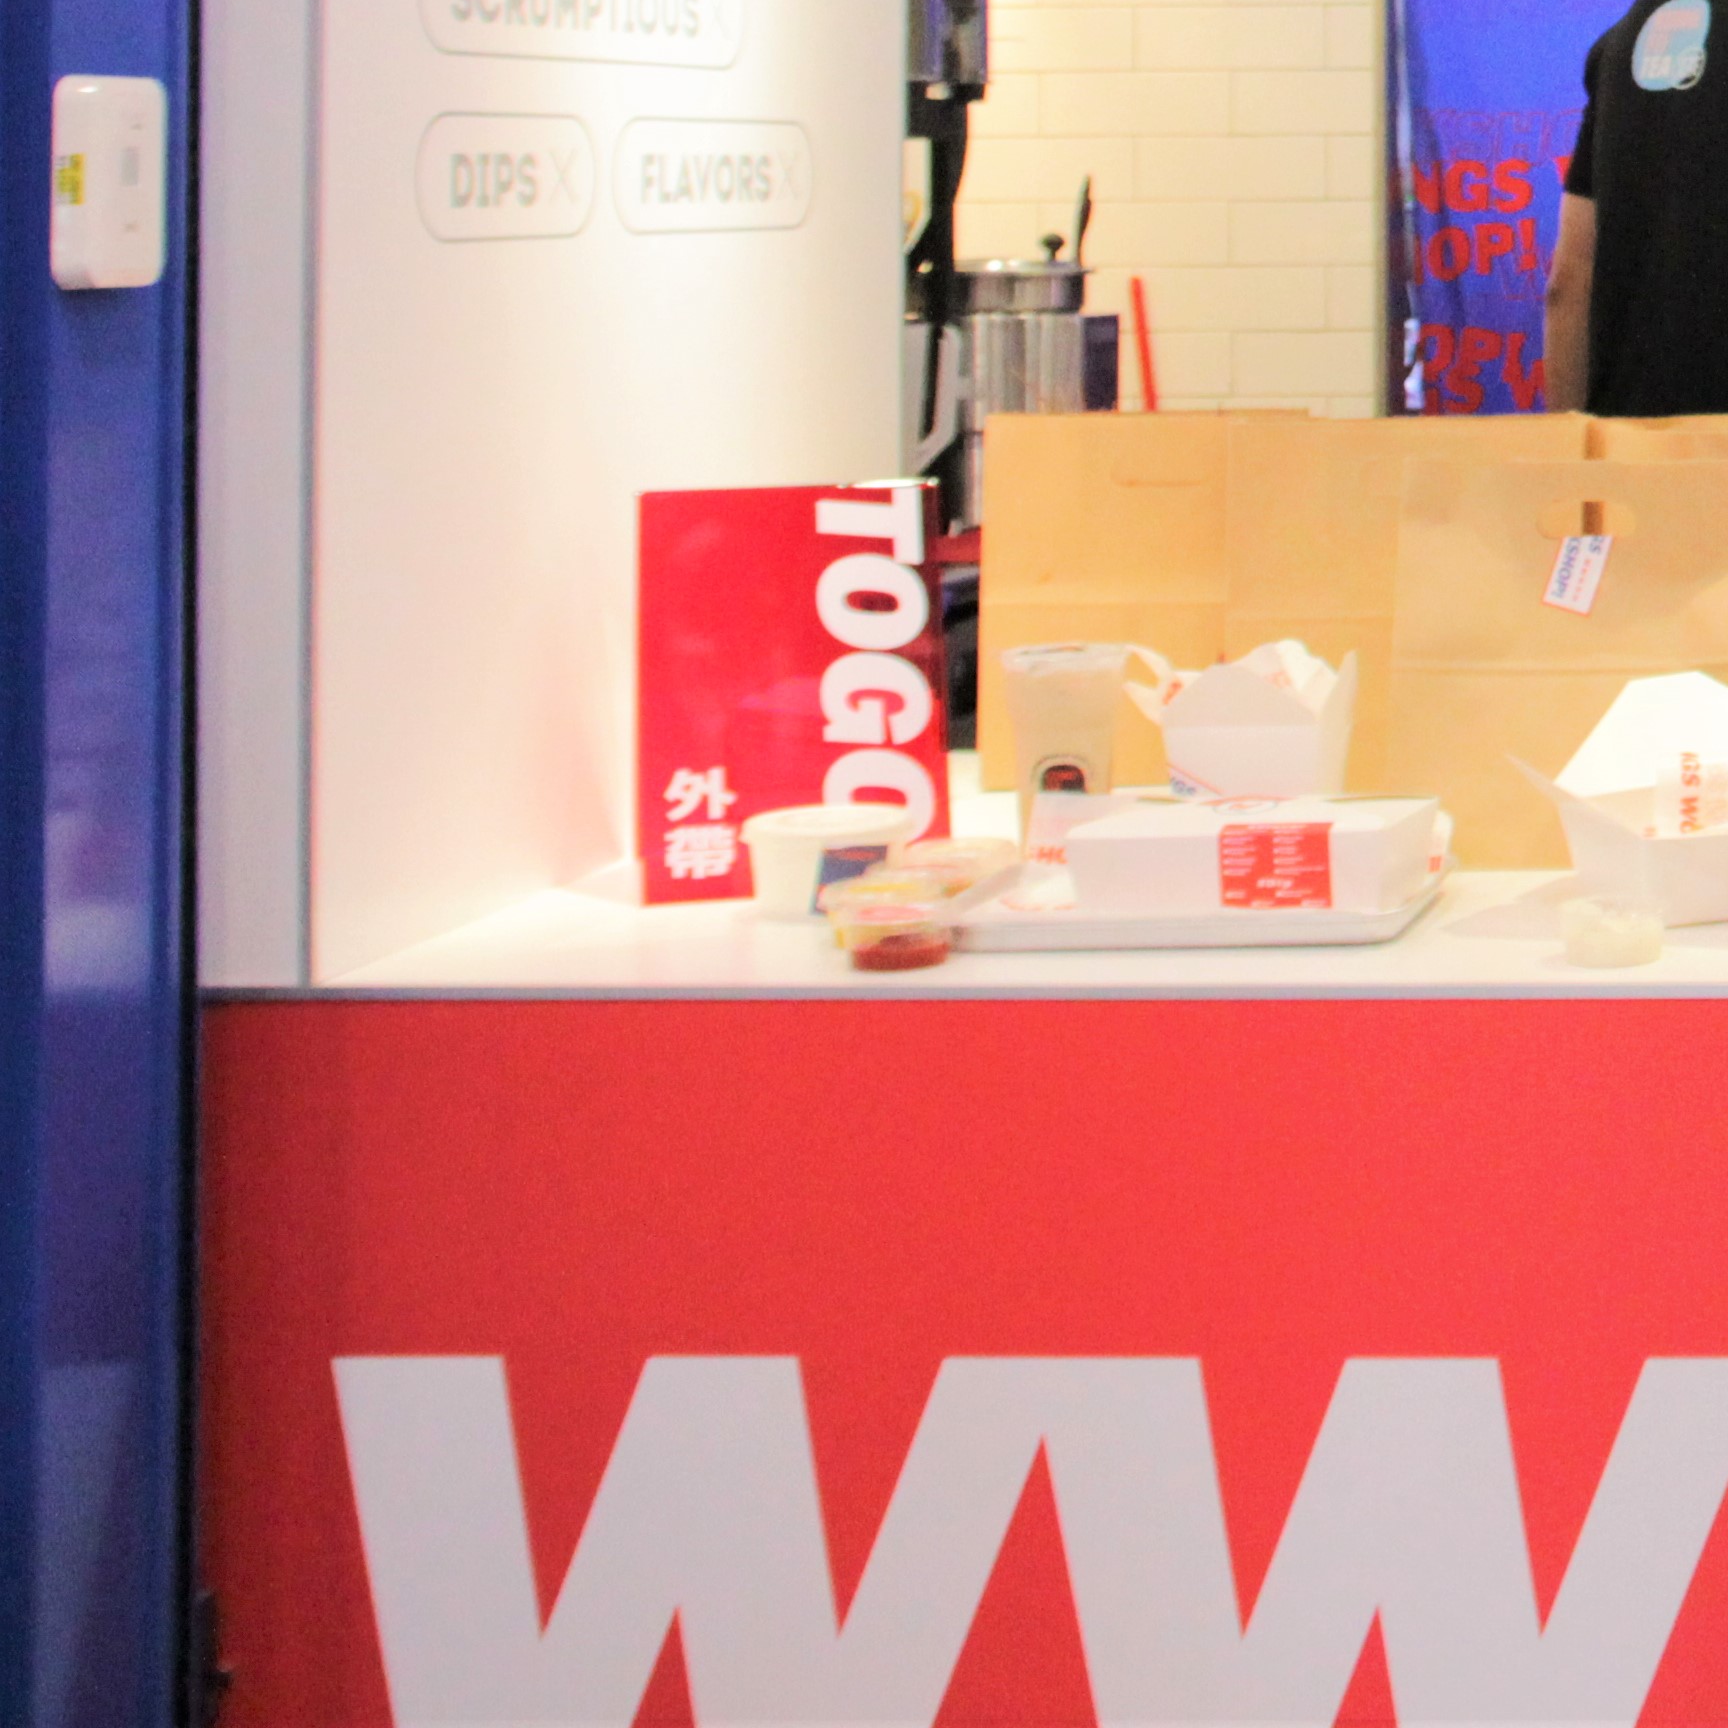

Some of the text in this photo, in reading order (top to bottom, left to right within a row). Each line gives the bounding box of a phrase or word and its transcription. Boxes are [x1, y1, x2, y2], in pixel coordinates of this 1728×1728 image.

[449, 152, 772, 209] DIPS FLAVORS
[664, 766, 738, 880] 外帶
